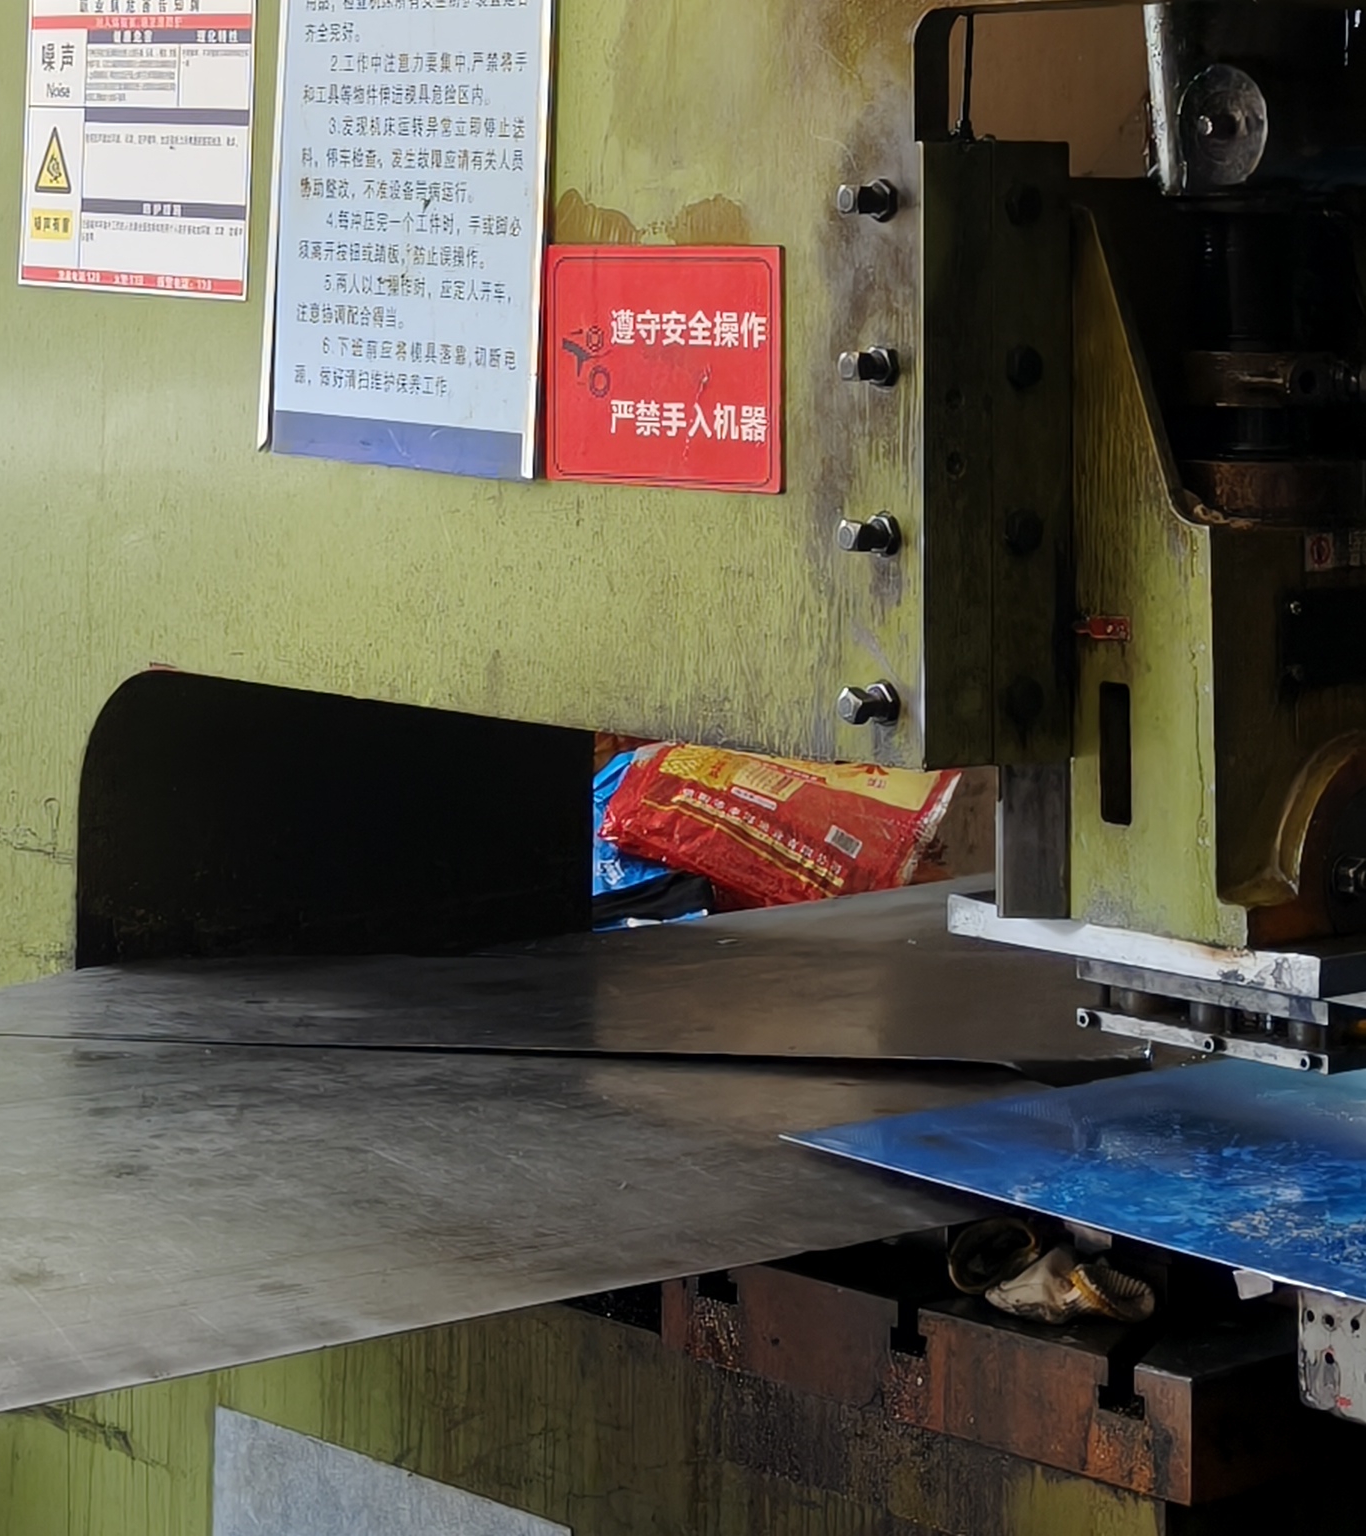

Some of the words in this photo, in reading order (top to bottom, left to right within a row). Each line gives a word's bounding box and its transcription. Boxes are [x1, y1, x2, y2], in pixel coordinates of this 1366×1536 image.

[41, 42, 75, 72] 噪声
[46, 82, 71, 99] Noise
[610, 309, 768, 349] 遵守安全操作
[610, 399, 770, 443] 严禁手入机器
